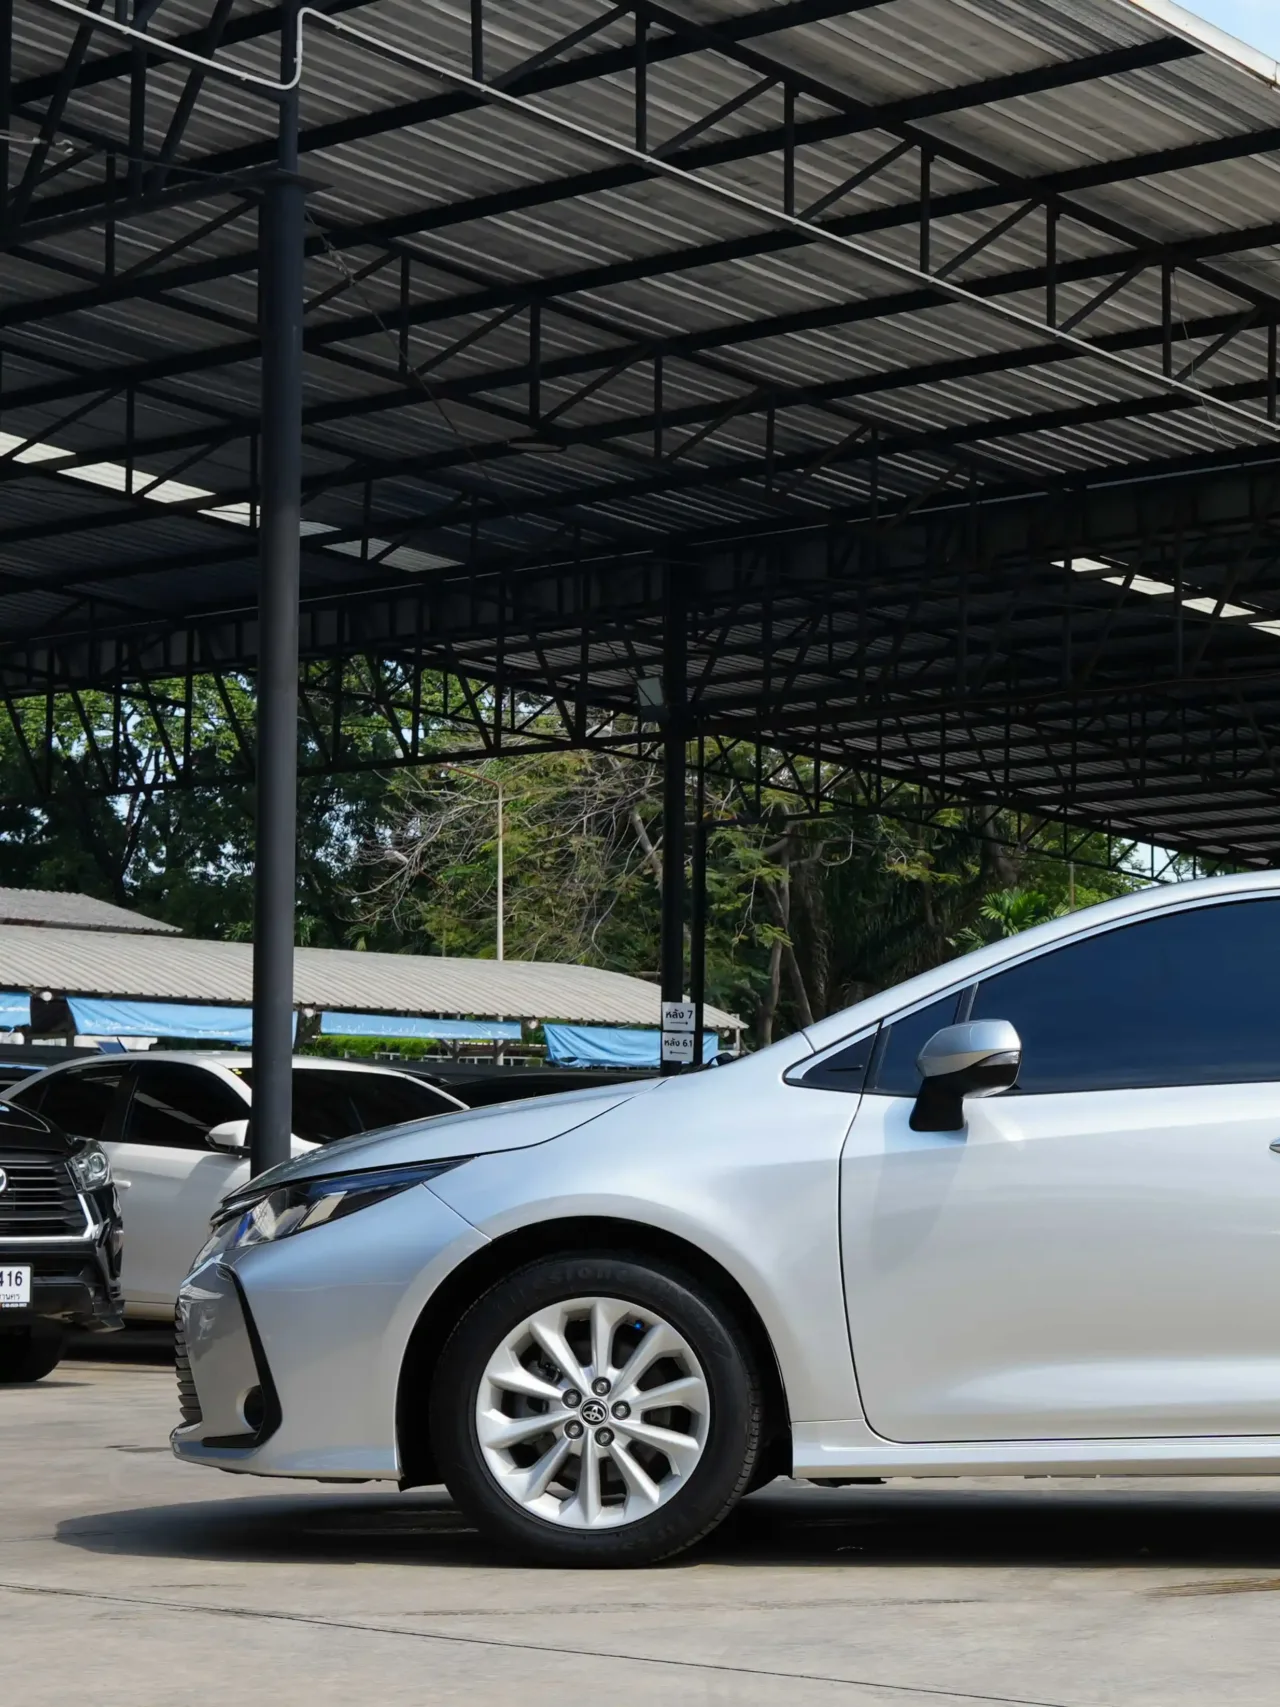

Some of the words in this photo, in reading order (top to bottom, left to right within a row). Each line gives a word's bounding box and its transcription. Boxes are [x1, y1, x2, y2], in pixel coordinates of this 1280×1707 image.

[665, 1009, 684, 1019] หลัง
[688, 1010, 694, 1019] 7
[682, 1039, 693, 1048] 6.1
